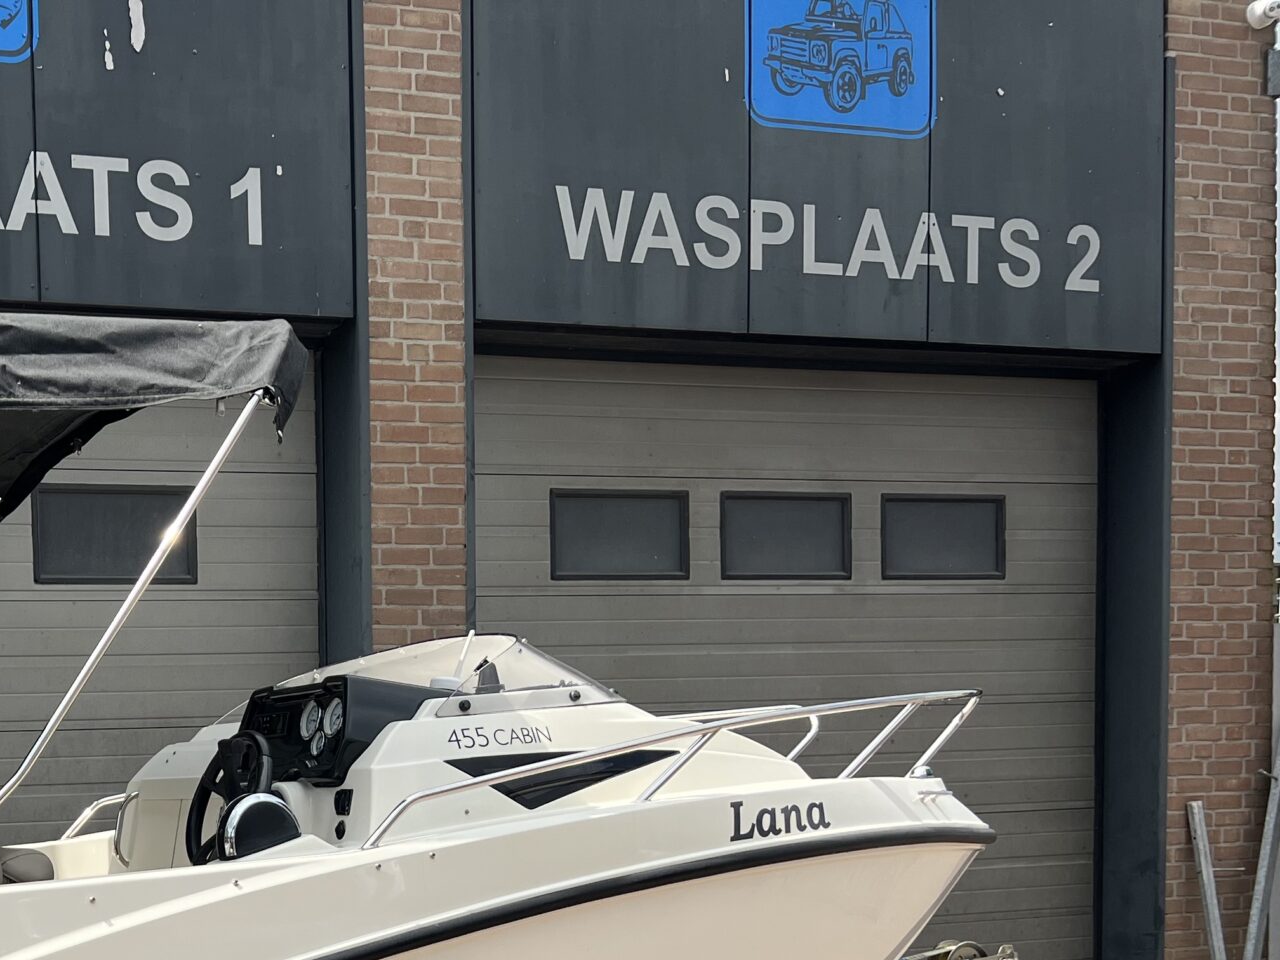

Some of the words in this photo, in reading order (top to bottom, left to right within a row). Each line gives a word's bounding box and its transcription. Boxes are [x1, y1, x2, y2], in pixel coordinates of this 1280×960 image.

[229, 166, 263, 246] 1
[555, 184, 1041, 289] WASPLAATS
[1065, 224, 1101, 293] 2
[447, 726, 489, 750] 455
[493, 725, 552, 746] CABIN
[729, 799, 831, 842] Lana
